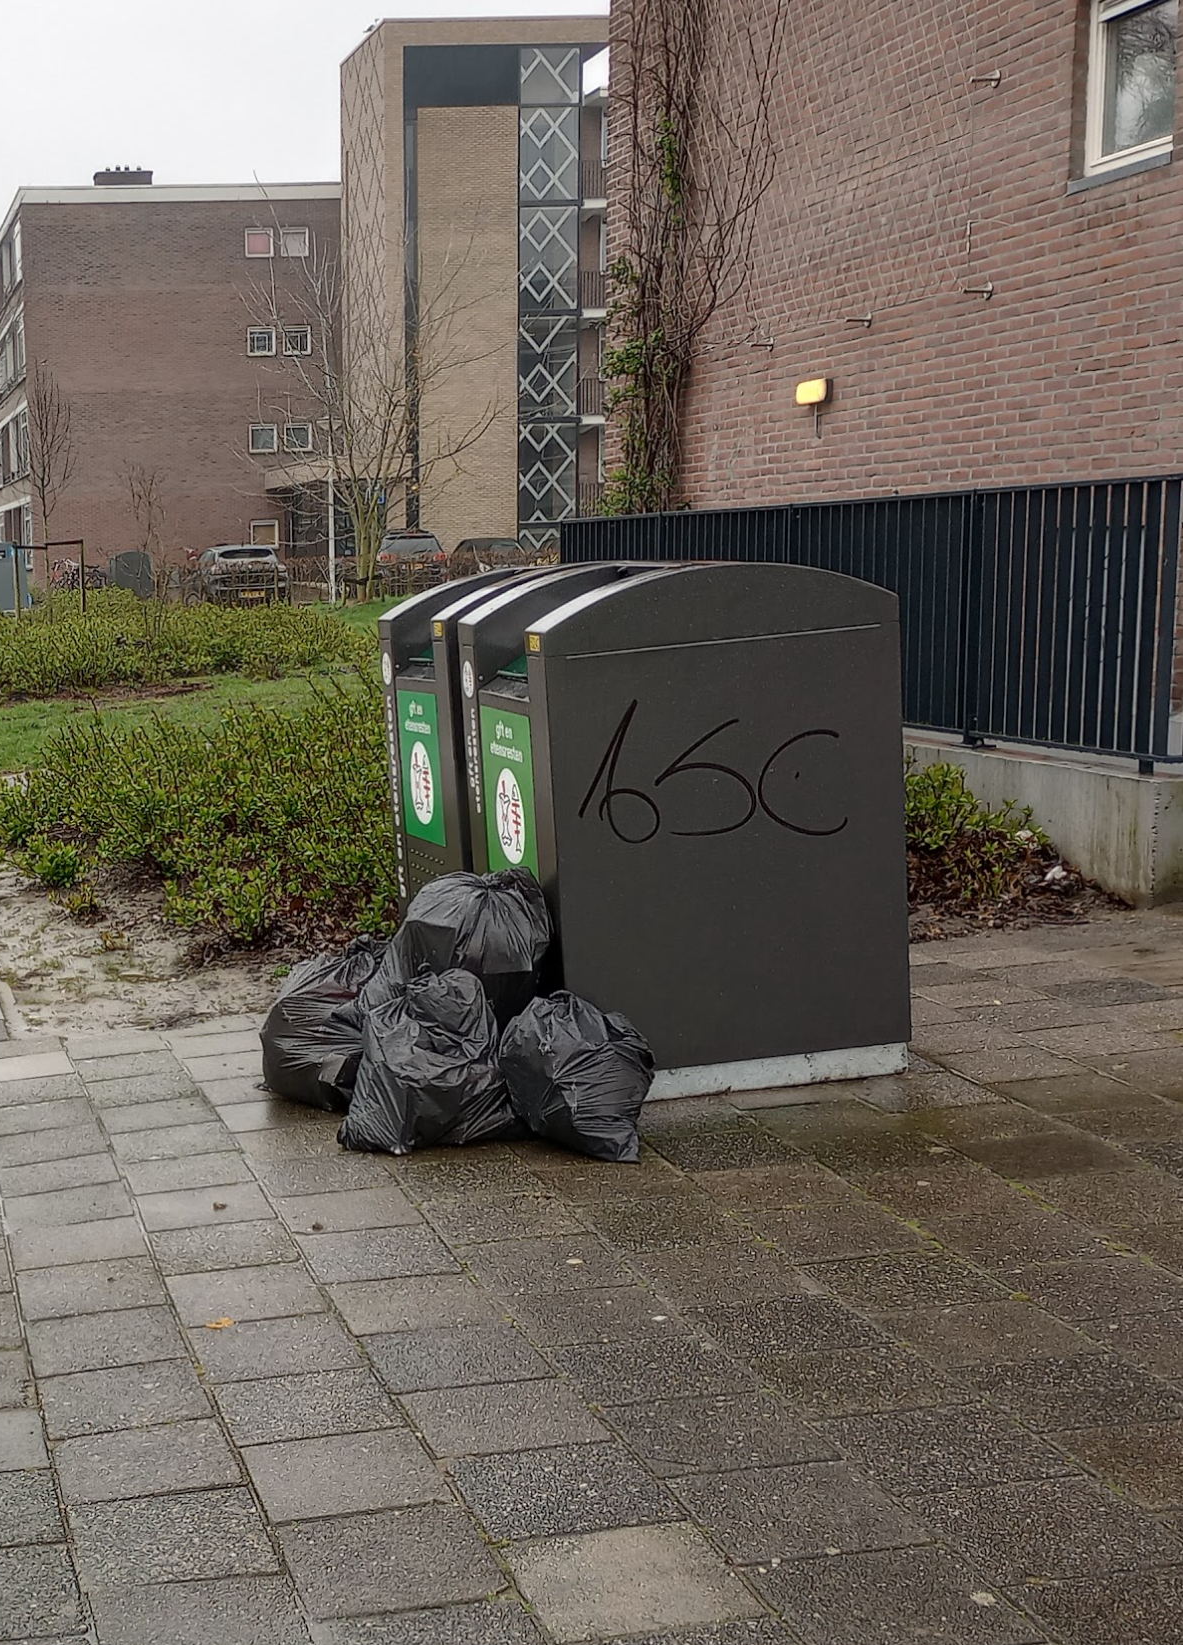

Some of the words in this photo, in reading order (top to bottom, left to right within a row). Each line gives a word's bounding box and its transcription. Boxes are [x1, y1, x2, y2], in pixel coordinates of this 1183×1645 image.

[495, 720, 504, 739] gft
[504, 726, 513, 740] en
[467, 735, 473, 757] en
[490, 740, 523, 763] etensresten
[386, 695, 400, 827] etensresten
[470, 708, 481, 814] etensresten
[396, 833, 403, 860] en
[397, 865, 407, 898] gft
